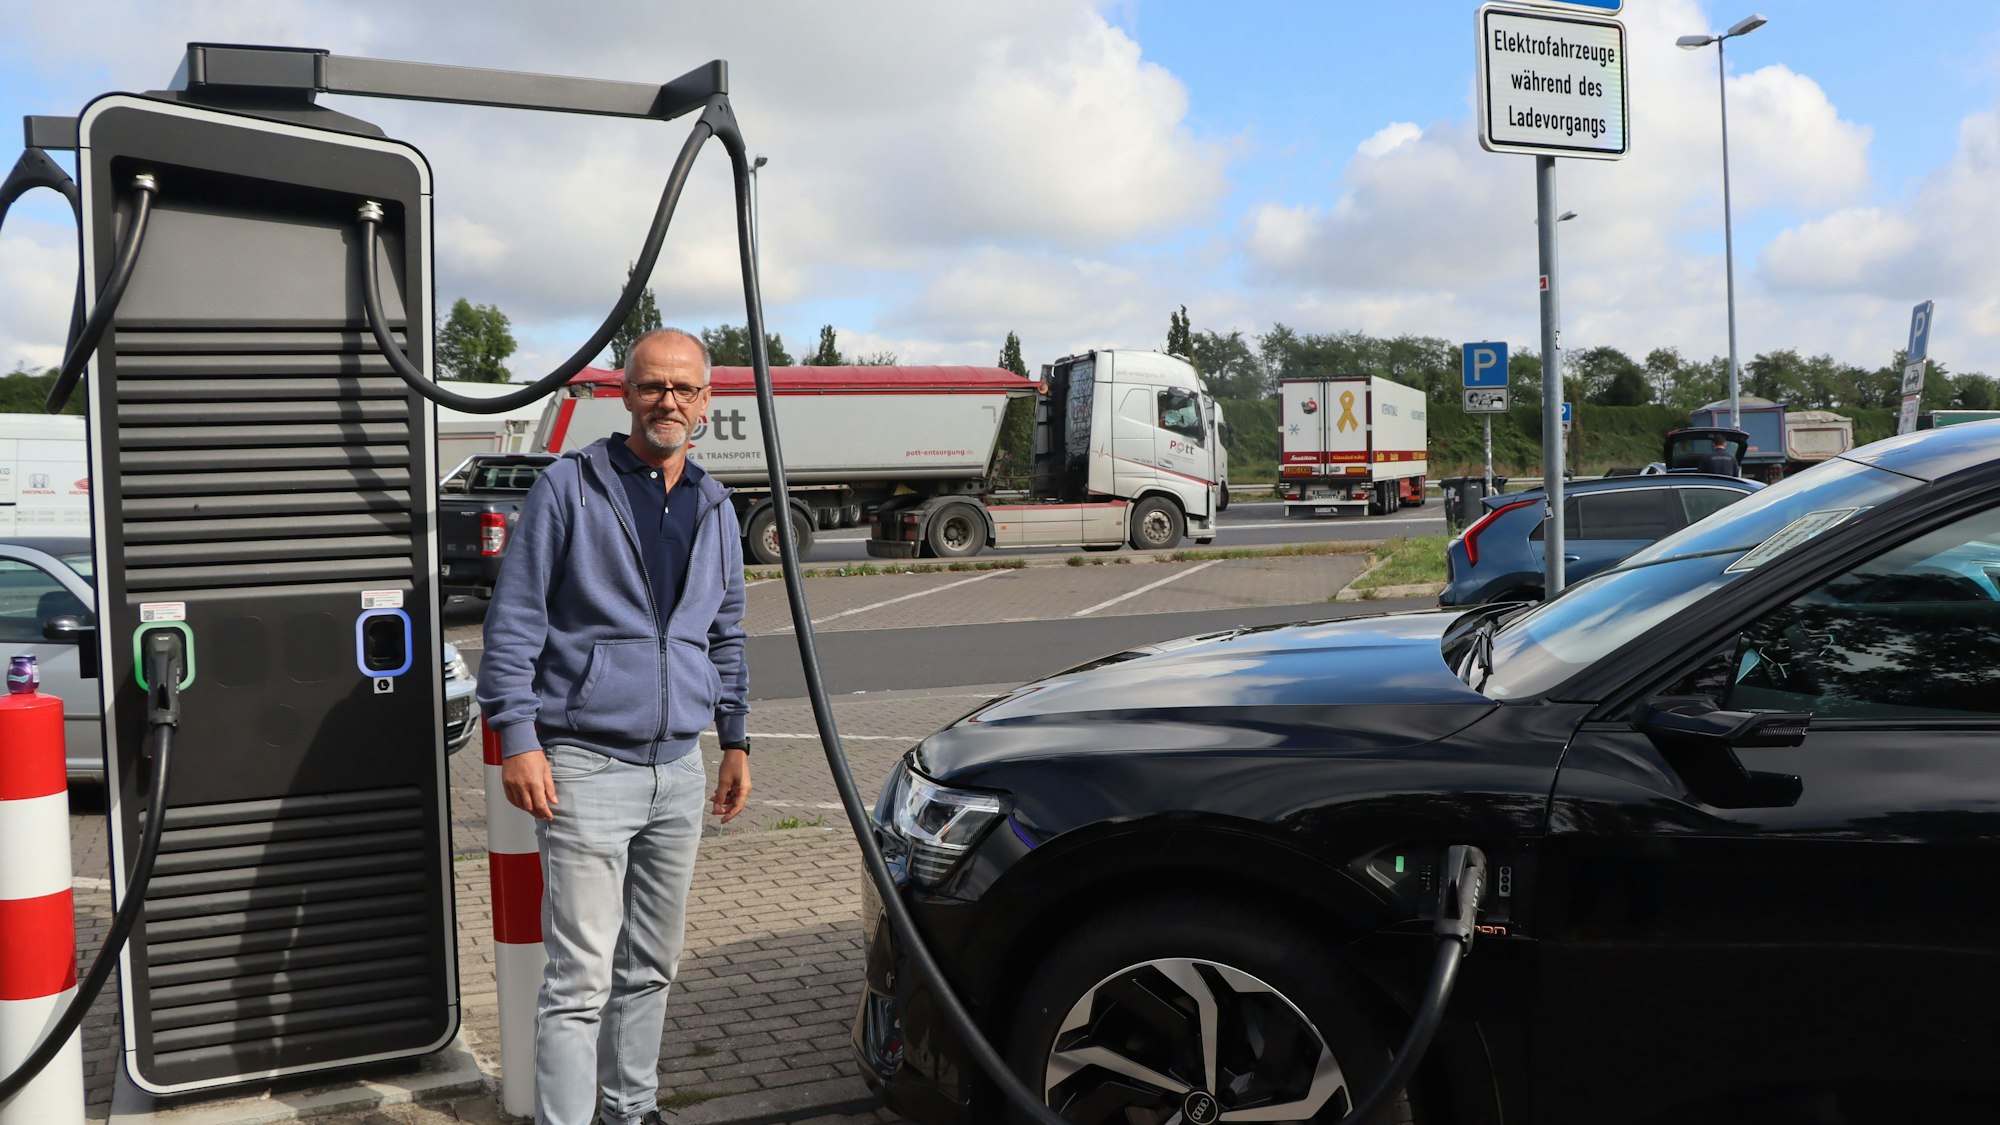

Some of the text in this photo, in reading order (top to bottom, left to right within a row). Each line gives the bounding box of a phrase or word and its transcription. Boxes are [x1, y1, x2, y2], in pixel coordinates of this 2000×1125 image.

[1494, 29, 1615, 67] Elektrofahrzeuge
[1511, 69, 1603, 97] während des
[1509, 105, 1606, 138] Ladevorgangs
[1911, 311, 1925, 354] P
[1474, 349, 1497, 381] P
[690, 410, 747, 441] ott
[706, 451, 761, 460] TRANSPORTE
